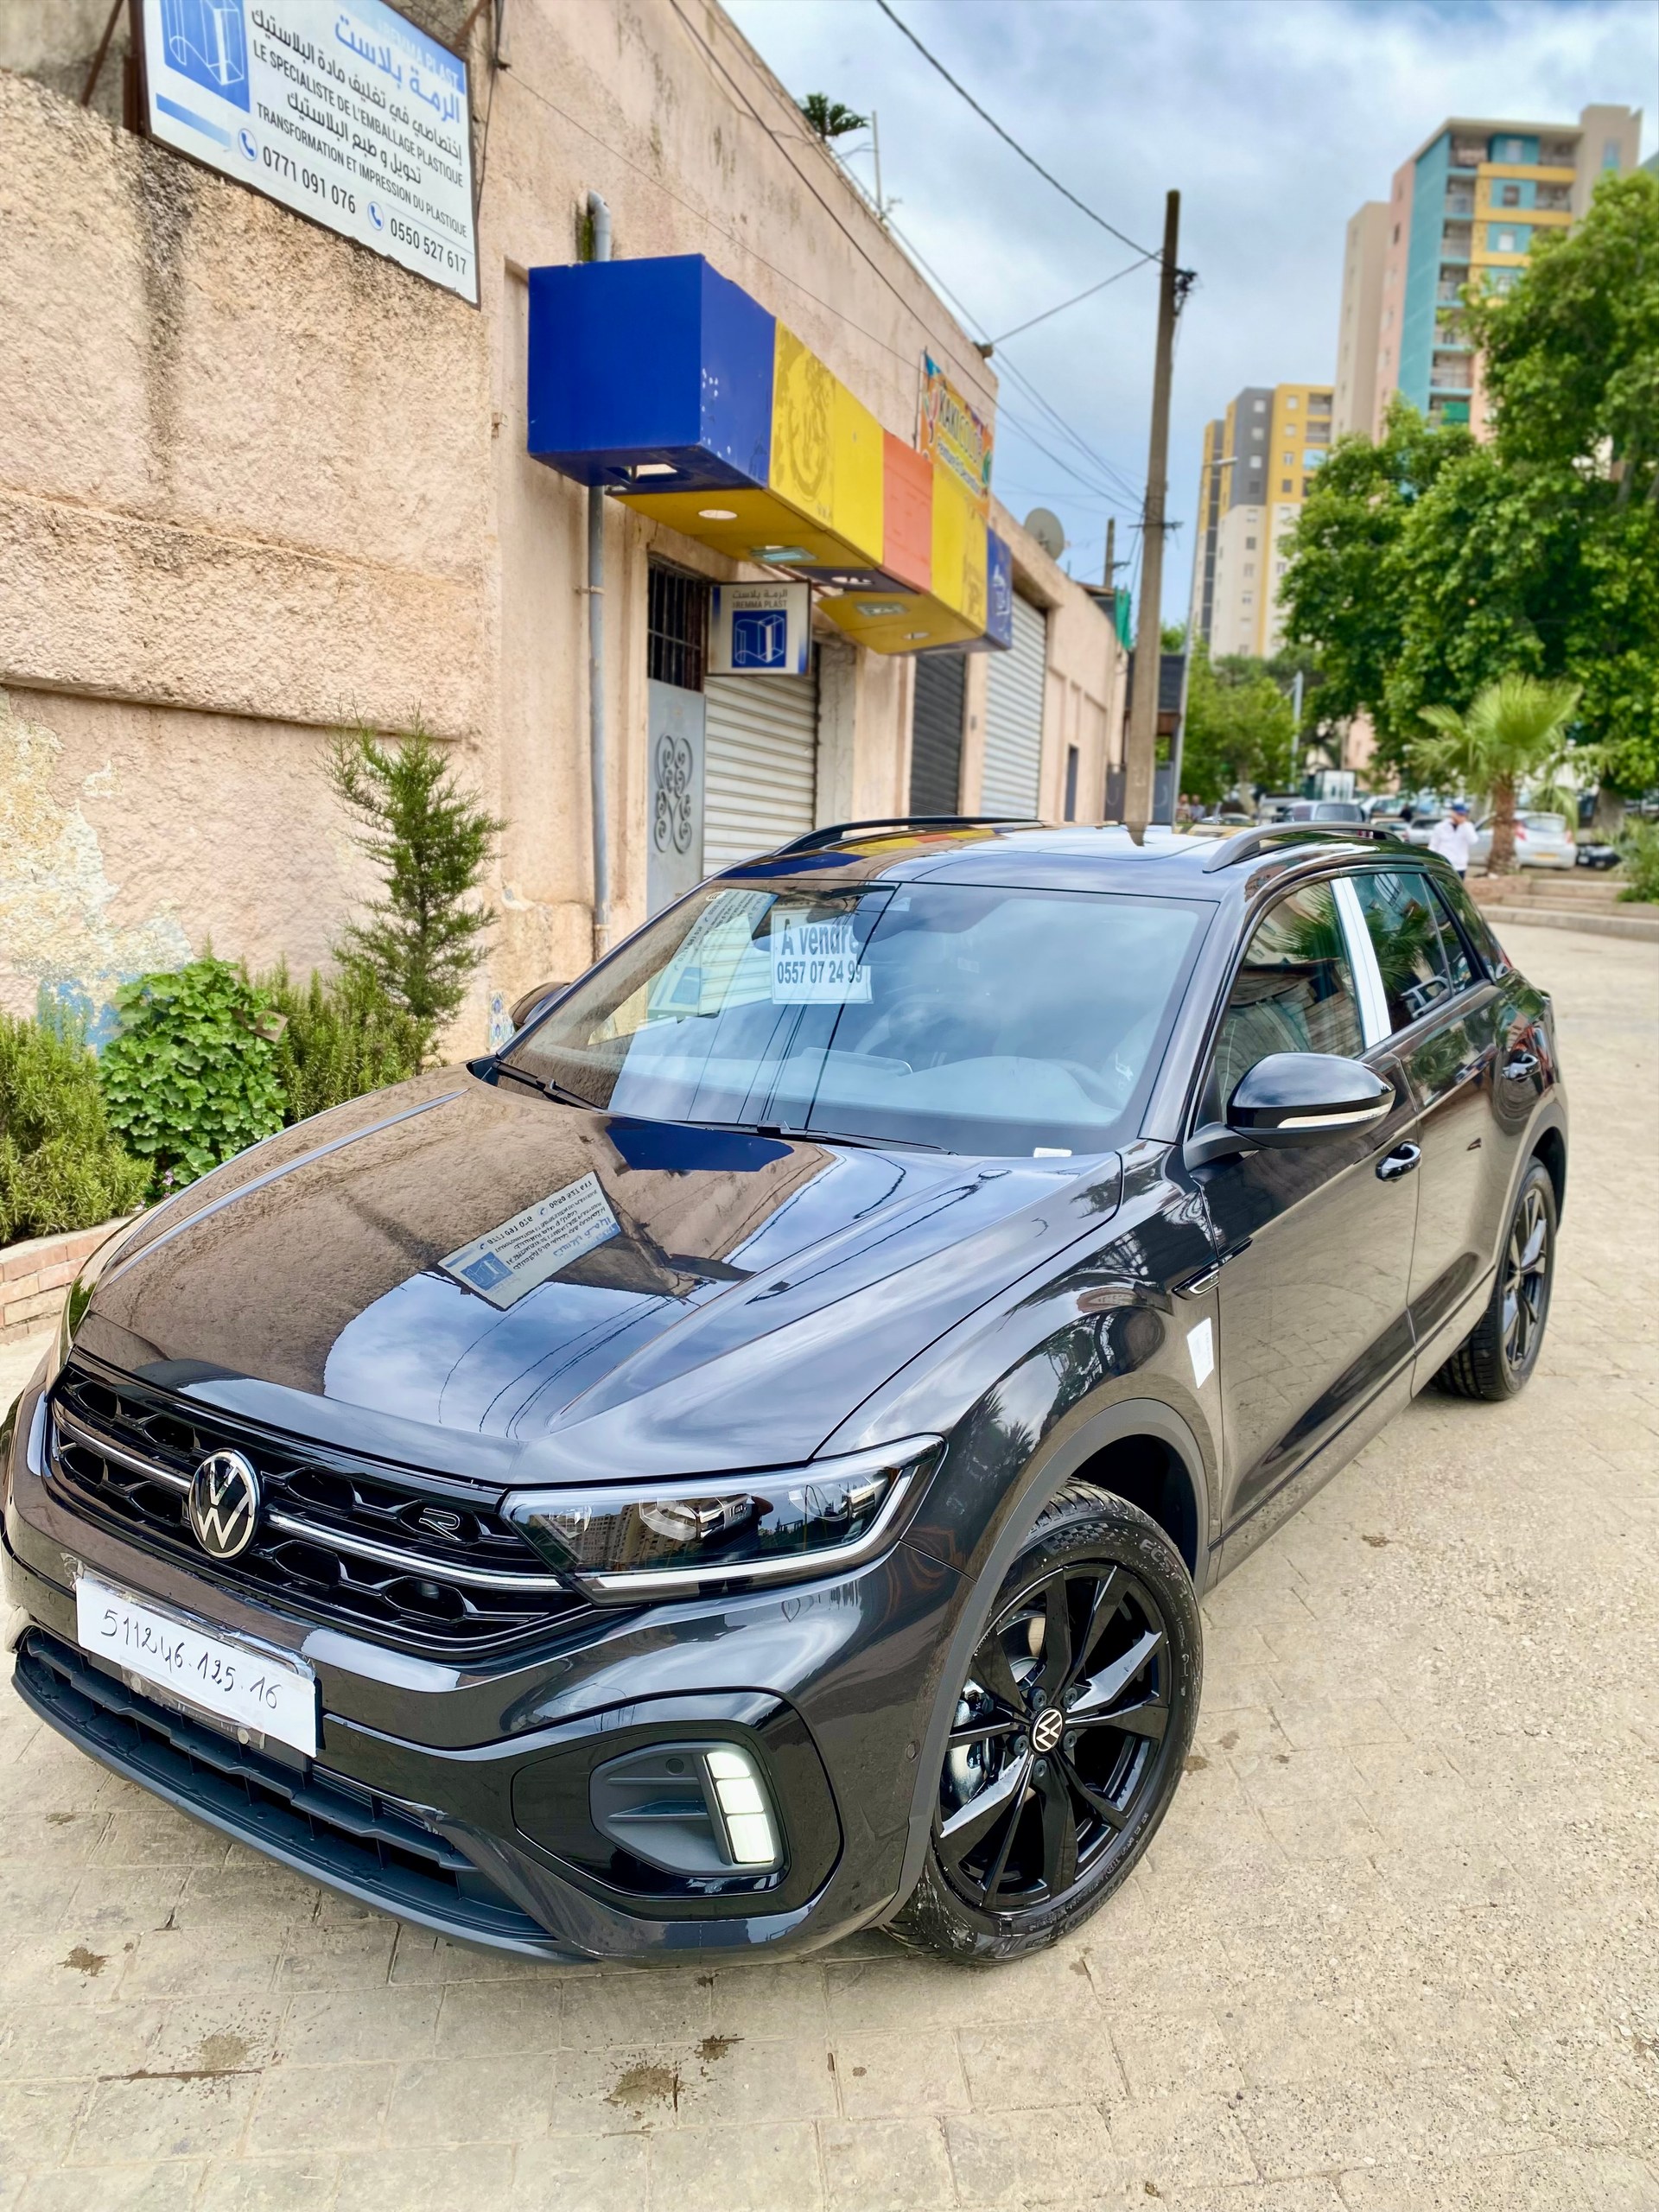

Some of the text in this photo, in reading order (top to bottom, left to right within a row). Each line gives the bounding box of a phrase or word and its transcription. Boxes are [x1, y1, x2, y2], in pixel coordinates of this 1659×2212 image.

[251, 10, 315, 65] البلاستيك
[335, 15, 402, 90] بلاست
[318, 48, 346, 84] مادة
[348, 73, 385, 109] تغليف
[253, 39, 464, 188] LE SPECIALISTE DE L'EMBALLAGE PLASTIQUE
[287, 92, 421, 184] تحويل و طبع البلاستيك
[390, 104, 409, 125] في
[257, 102, 467, 238] TRANSFORMATION ET IMPRESSION DU PLASTIQUE
[263, 145, 356, 214] 0771 091 076
[391, 218, 467, 275] 0550 527 617
[764, 600, 787, 608] PLAST
[778, 960, 862, 984] 0557 07 24 99
